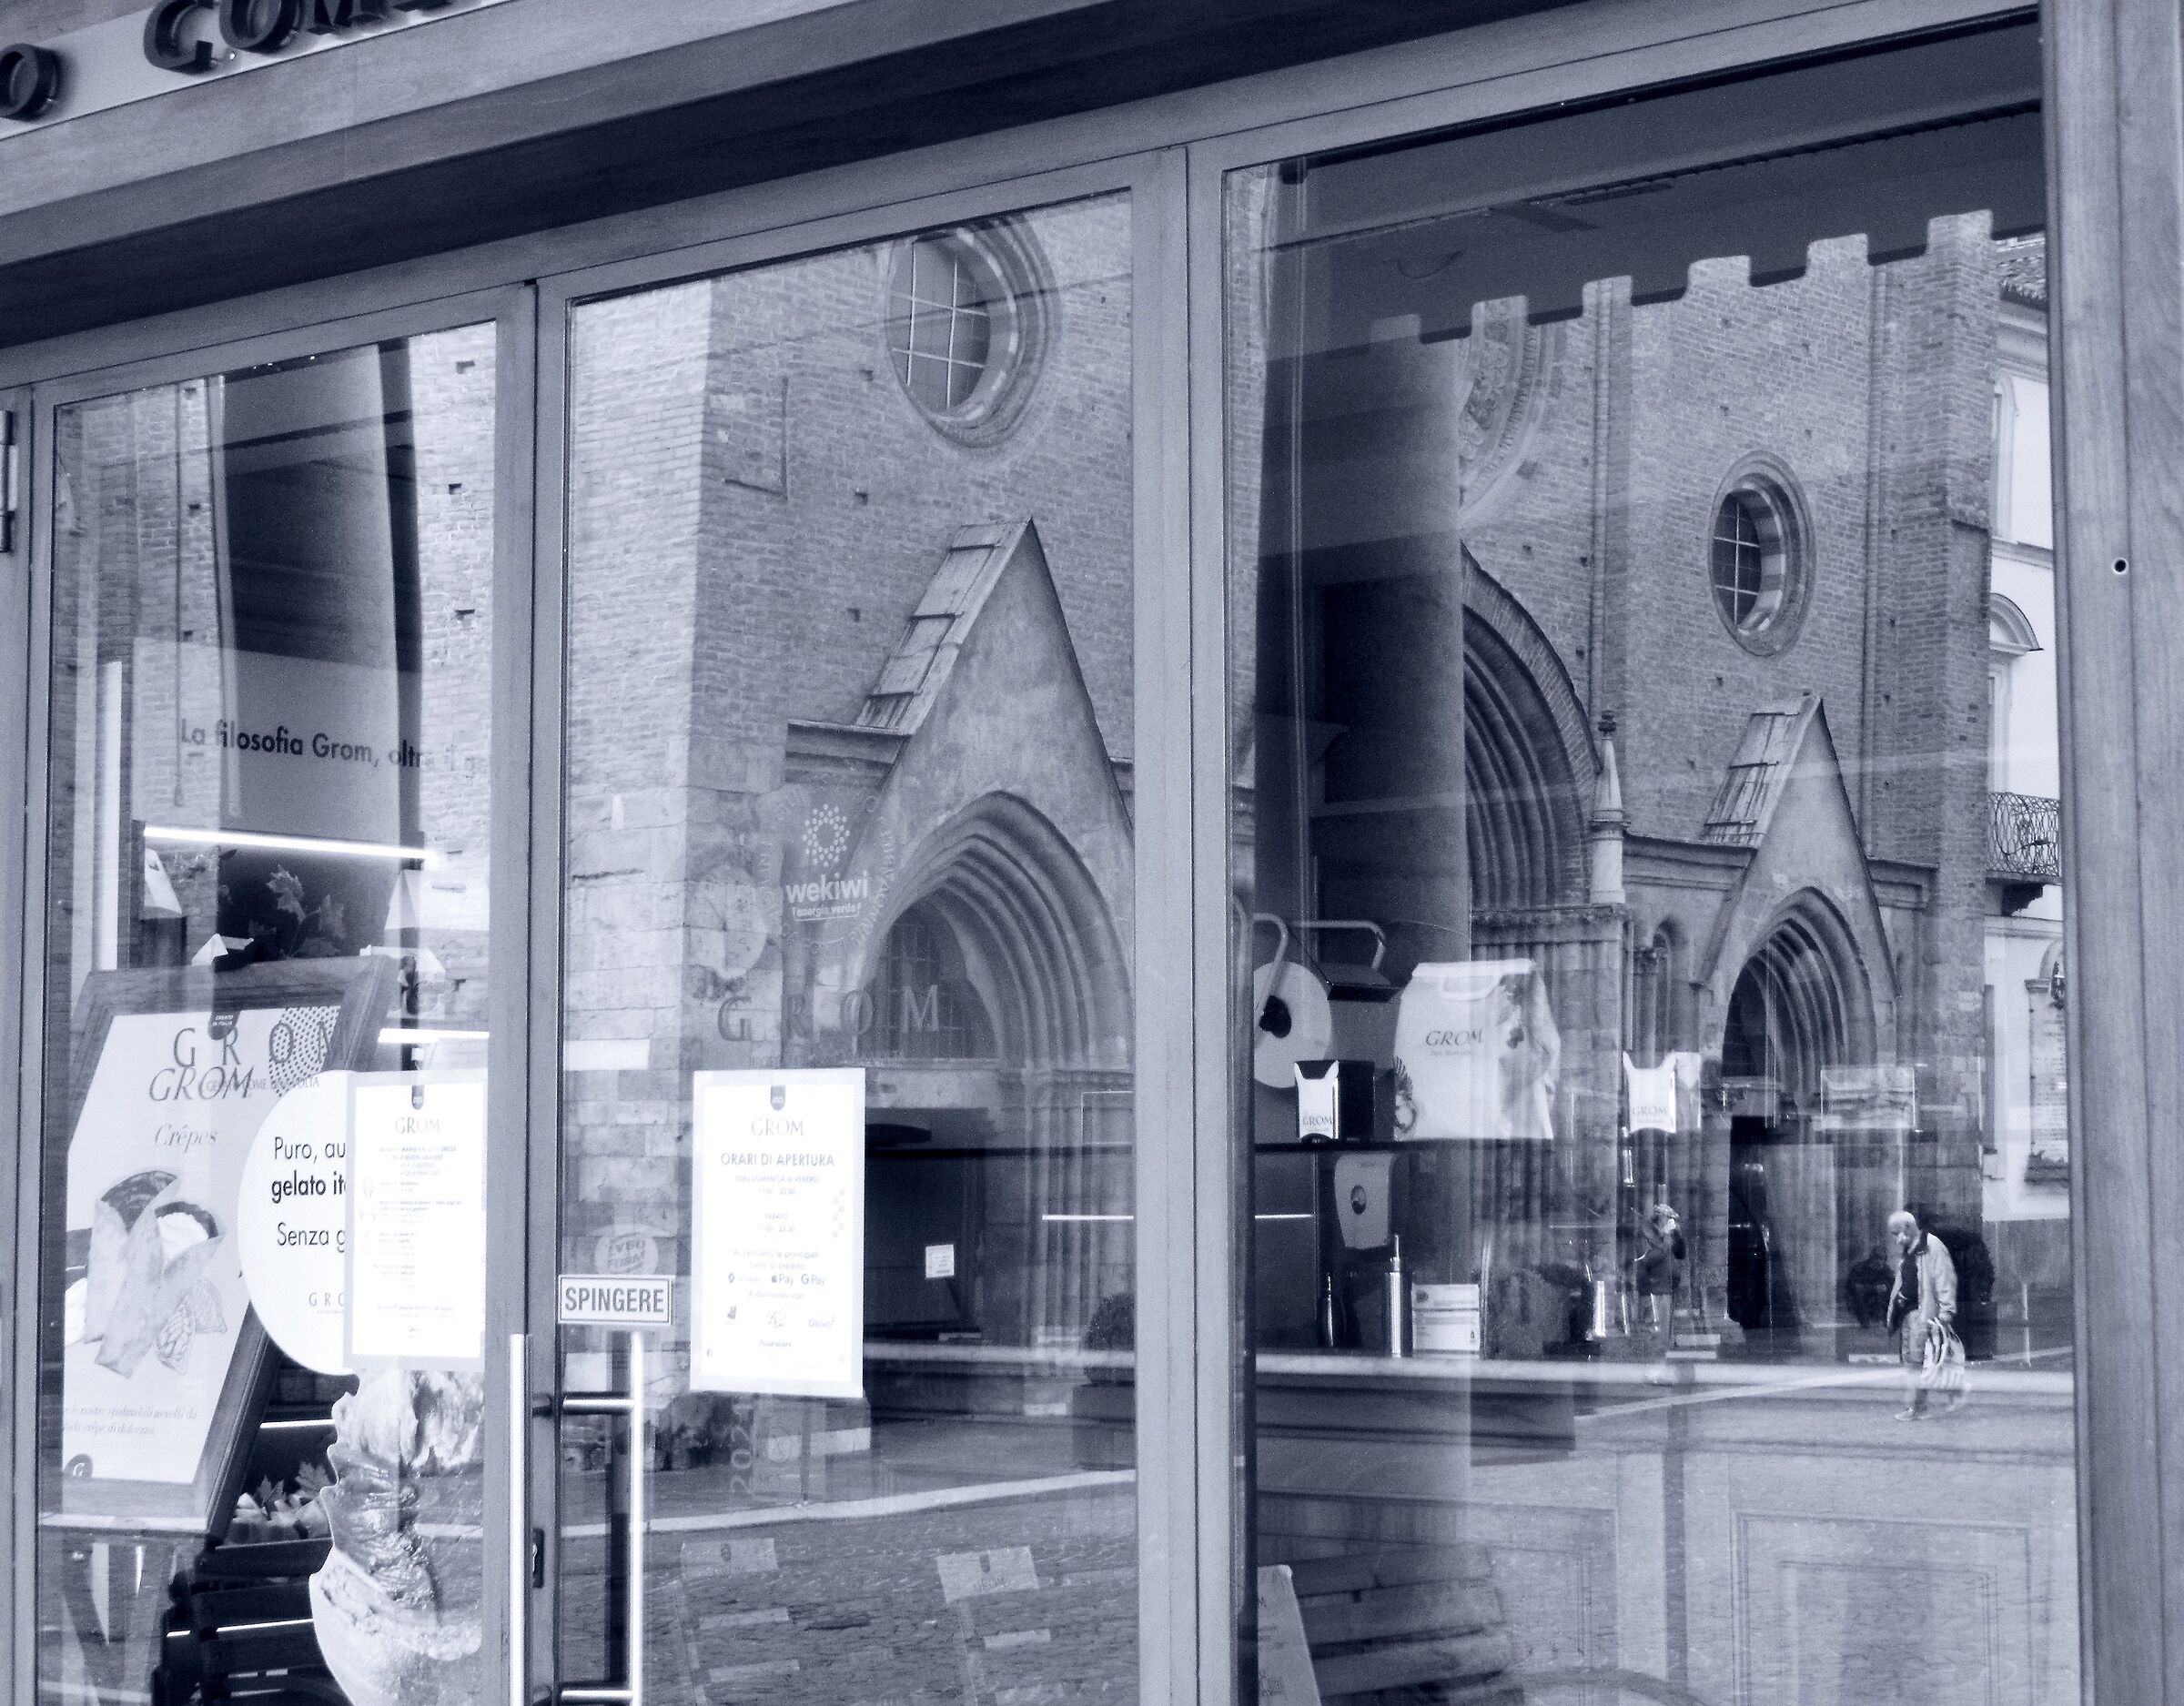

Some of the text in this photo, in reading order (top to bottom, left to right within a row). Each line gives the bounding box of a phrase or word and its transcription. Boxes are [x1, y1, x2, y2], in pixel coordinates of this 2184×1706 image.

[181, 719, 206, 745] La
[215, 720, 304, 756] filosofia
[312, 732, 379, 768] Grom,
[785, 870, 869, 903] wekiwi
[717, 984, 939, 1042] GROM
[1425, 1029, 1483, 1046] GROM
[148, 1065, 254, 1102] GROM
[1302, 1115, 1335, 1126] GROM
[1633, 1105, 1667, 1117] GROM
[395, 1116, 440, 1134] GROM
[751, 1118, 804, 1136] GROM
[154, 1124, 218, 1153] Crêpes
[274, 1136, 318, 1164] Puro,
[720, 1153, 835, 1166] ORARI DI APERTURA
[271, 1169, 327, 1204] gelato
[277, 1221, 329, 1247] Senza
[784, 1250, 819, 1260] principali
[779, 1273, 794, 1286] Pay
[564, 1287, 664, 1313] SPINGERE
[808, 1318, 832, 1329] Glovo
